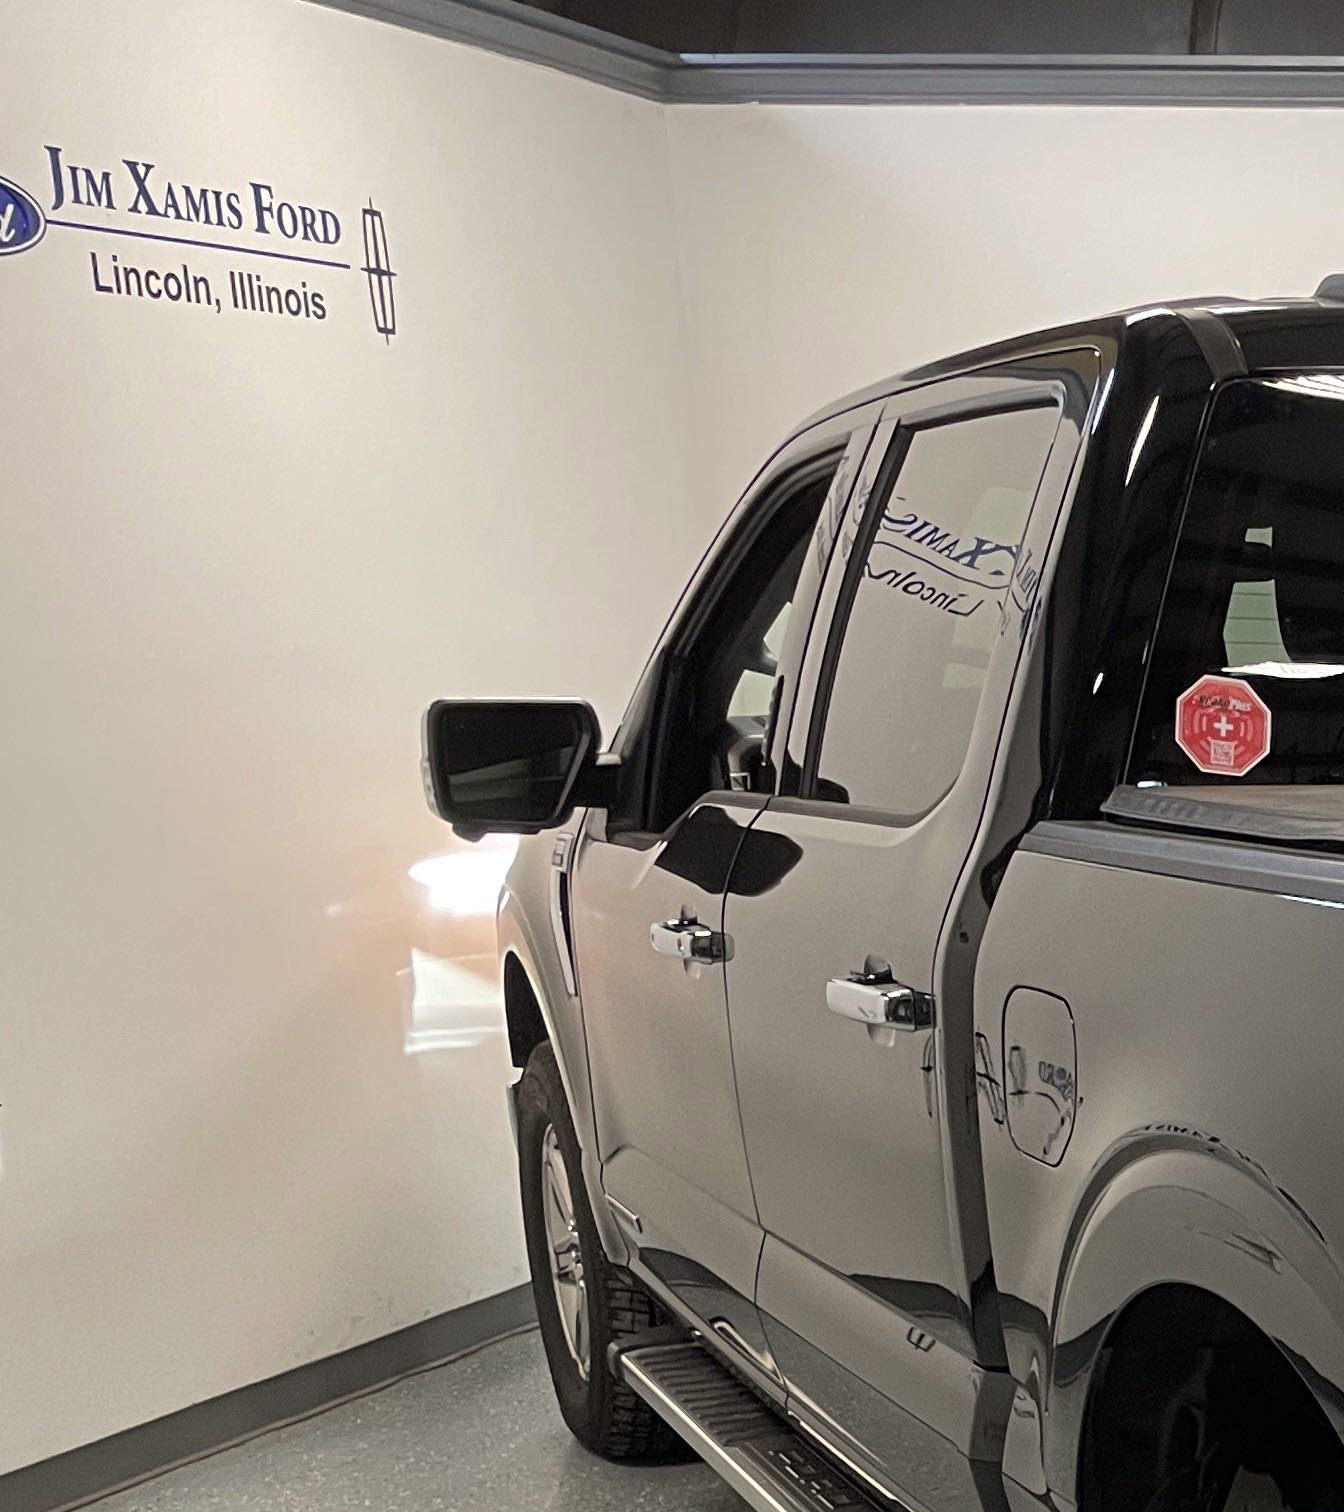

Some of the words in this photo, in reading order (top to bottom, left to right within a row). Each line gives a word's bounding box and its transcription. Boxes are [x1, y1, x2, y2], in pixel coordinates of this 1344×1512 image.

[44, 145, 115, 211] JIM
[121, 159, 243, 231] XAMIS
[249, 182, 342, 246] FORD
[90, 252, 222, 314] Lincoln,
[230, 271, 327, 321] Illinois
